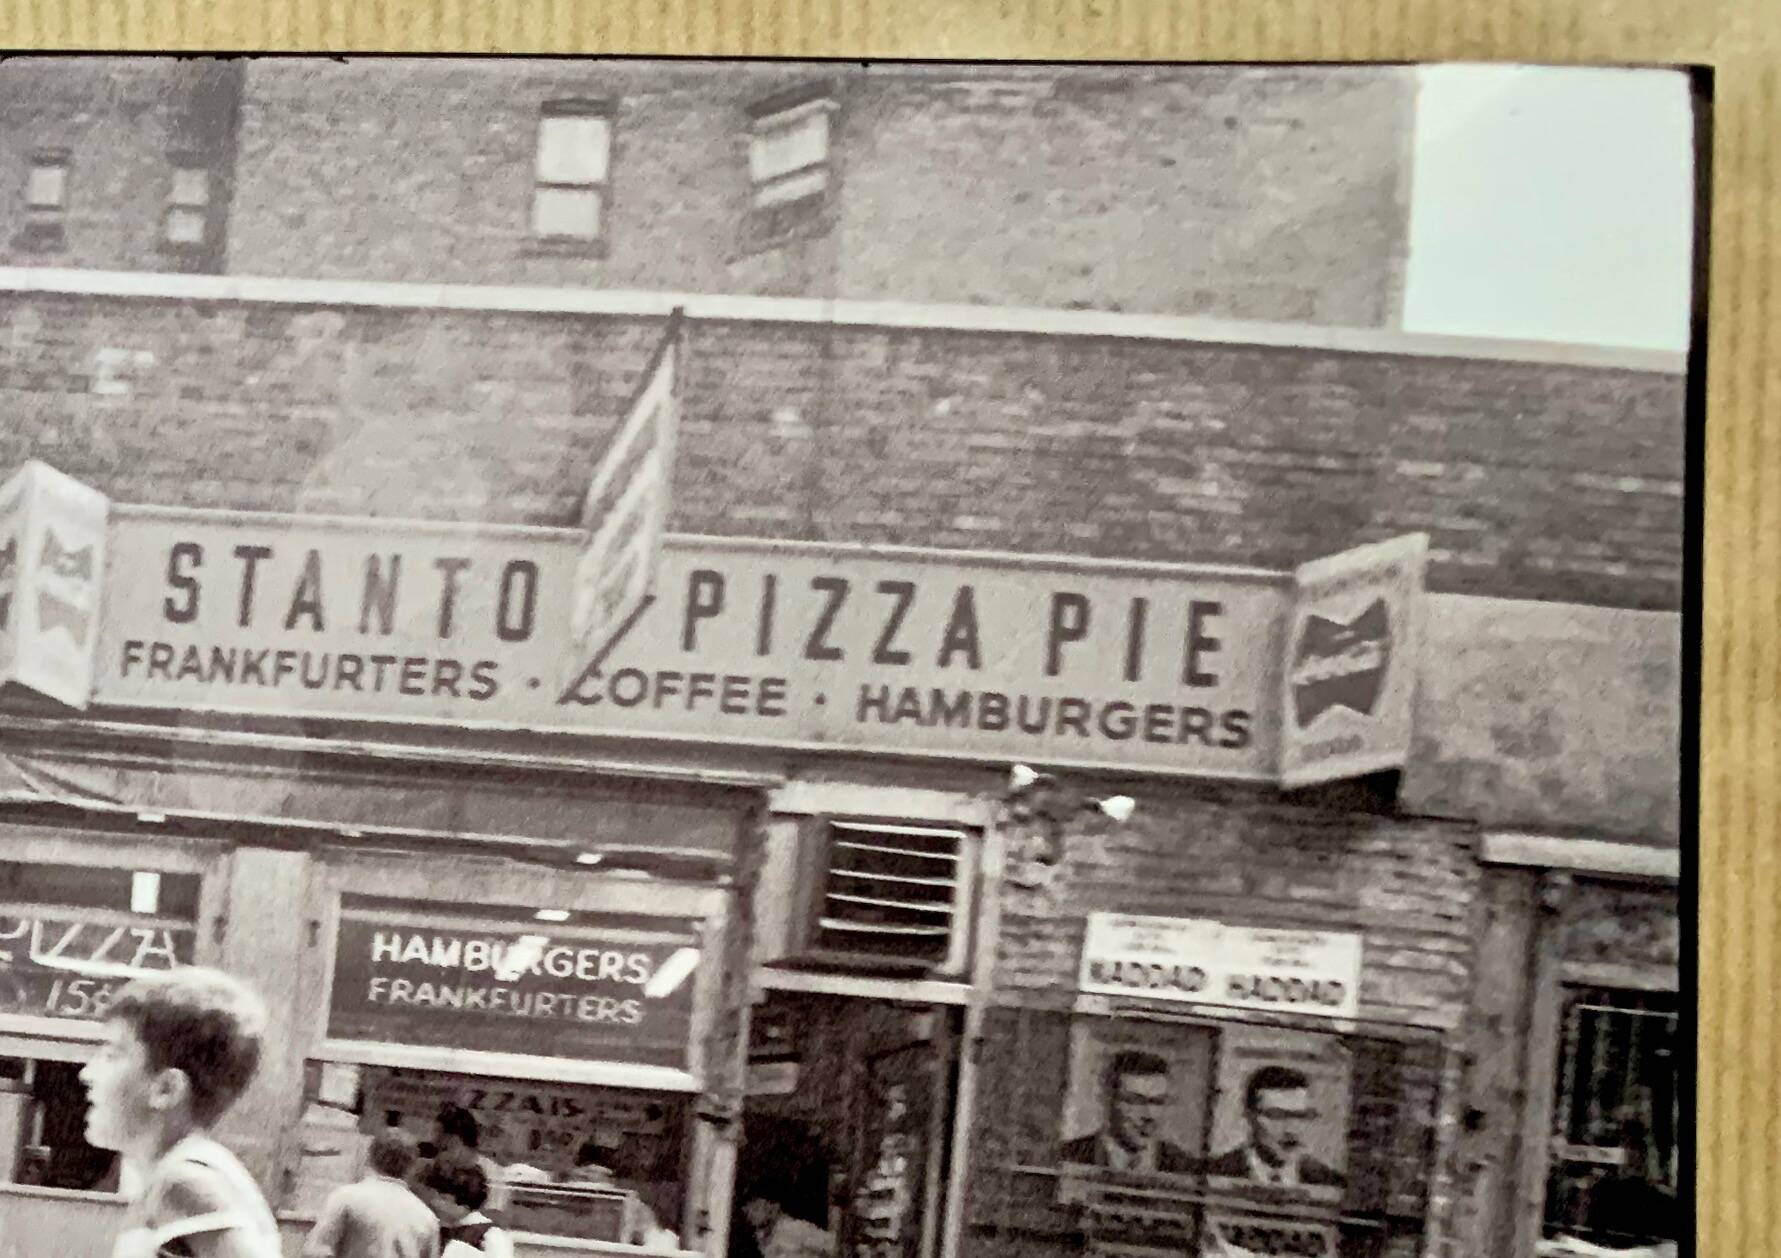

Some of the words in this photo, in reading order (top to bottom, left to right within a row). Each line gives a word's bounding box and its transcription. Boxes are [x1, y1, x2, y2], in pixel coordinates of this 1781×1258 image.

[163, 541, 539, 642] STANTO
[683, 568, 982, 670] PIZZA
[1047, 591, 1222, 687] PIE
[120, 640, 499, 700] FRANKFURTERS
[572, 667, 787, 716] COFFEE
[857, 683, 1252, 750] HAMBURGERS
[371, 932, 650, 984] HAMBGERS
[368, 977, 645, 1024] FRANKFURTERS
